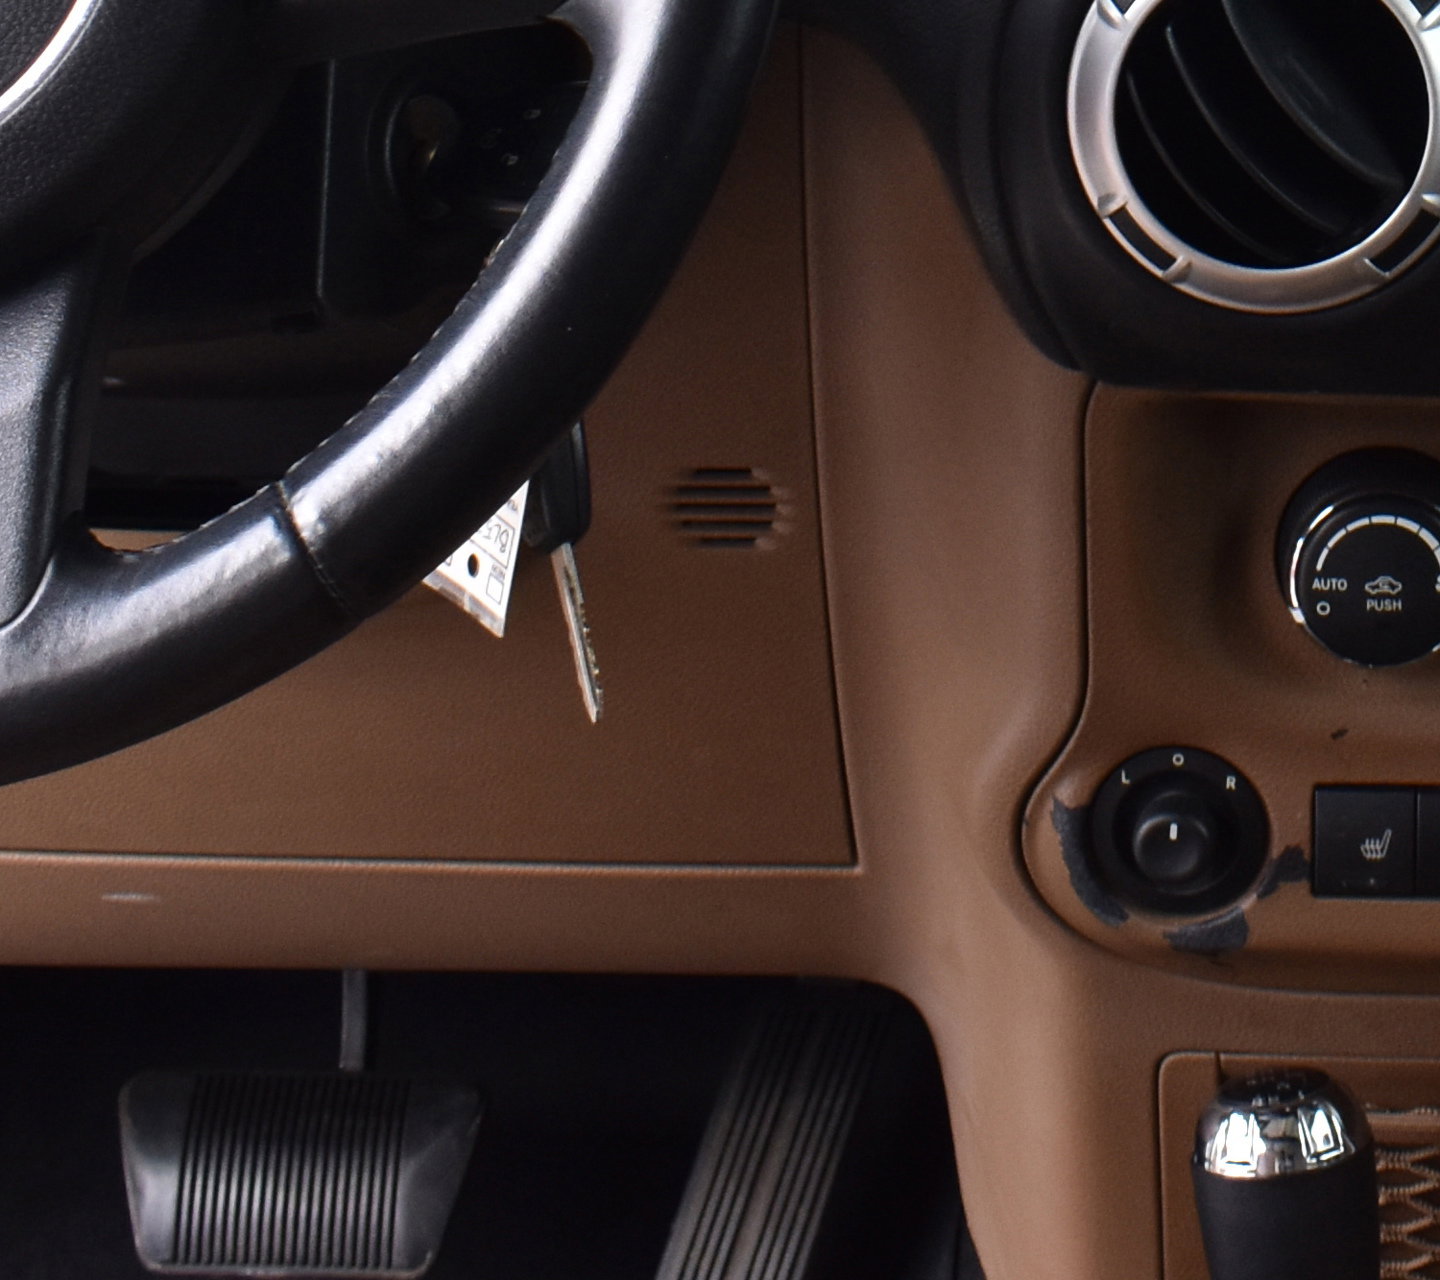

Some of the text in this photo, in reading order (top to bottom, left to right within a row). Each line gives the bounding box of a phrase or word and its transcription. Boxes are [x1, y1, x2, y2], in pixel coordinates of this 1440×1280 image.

[1312, 578, 1348, 592] AUTO
[1366, 599, 1402, 612] PUSH
[1121, 770, 1130, 784] L
[1226, 776, 1236, 790] R
